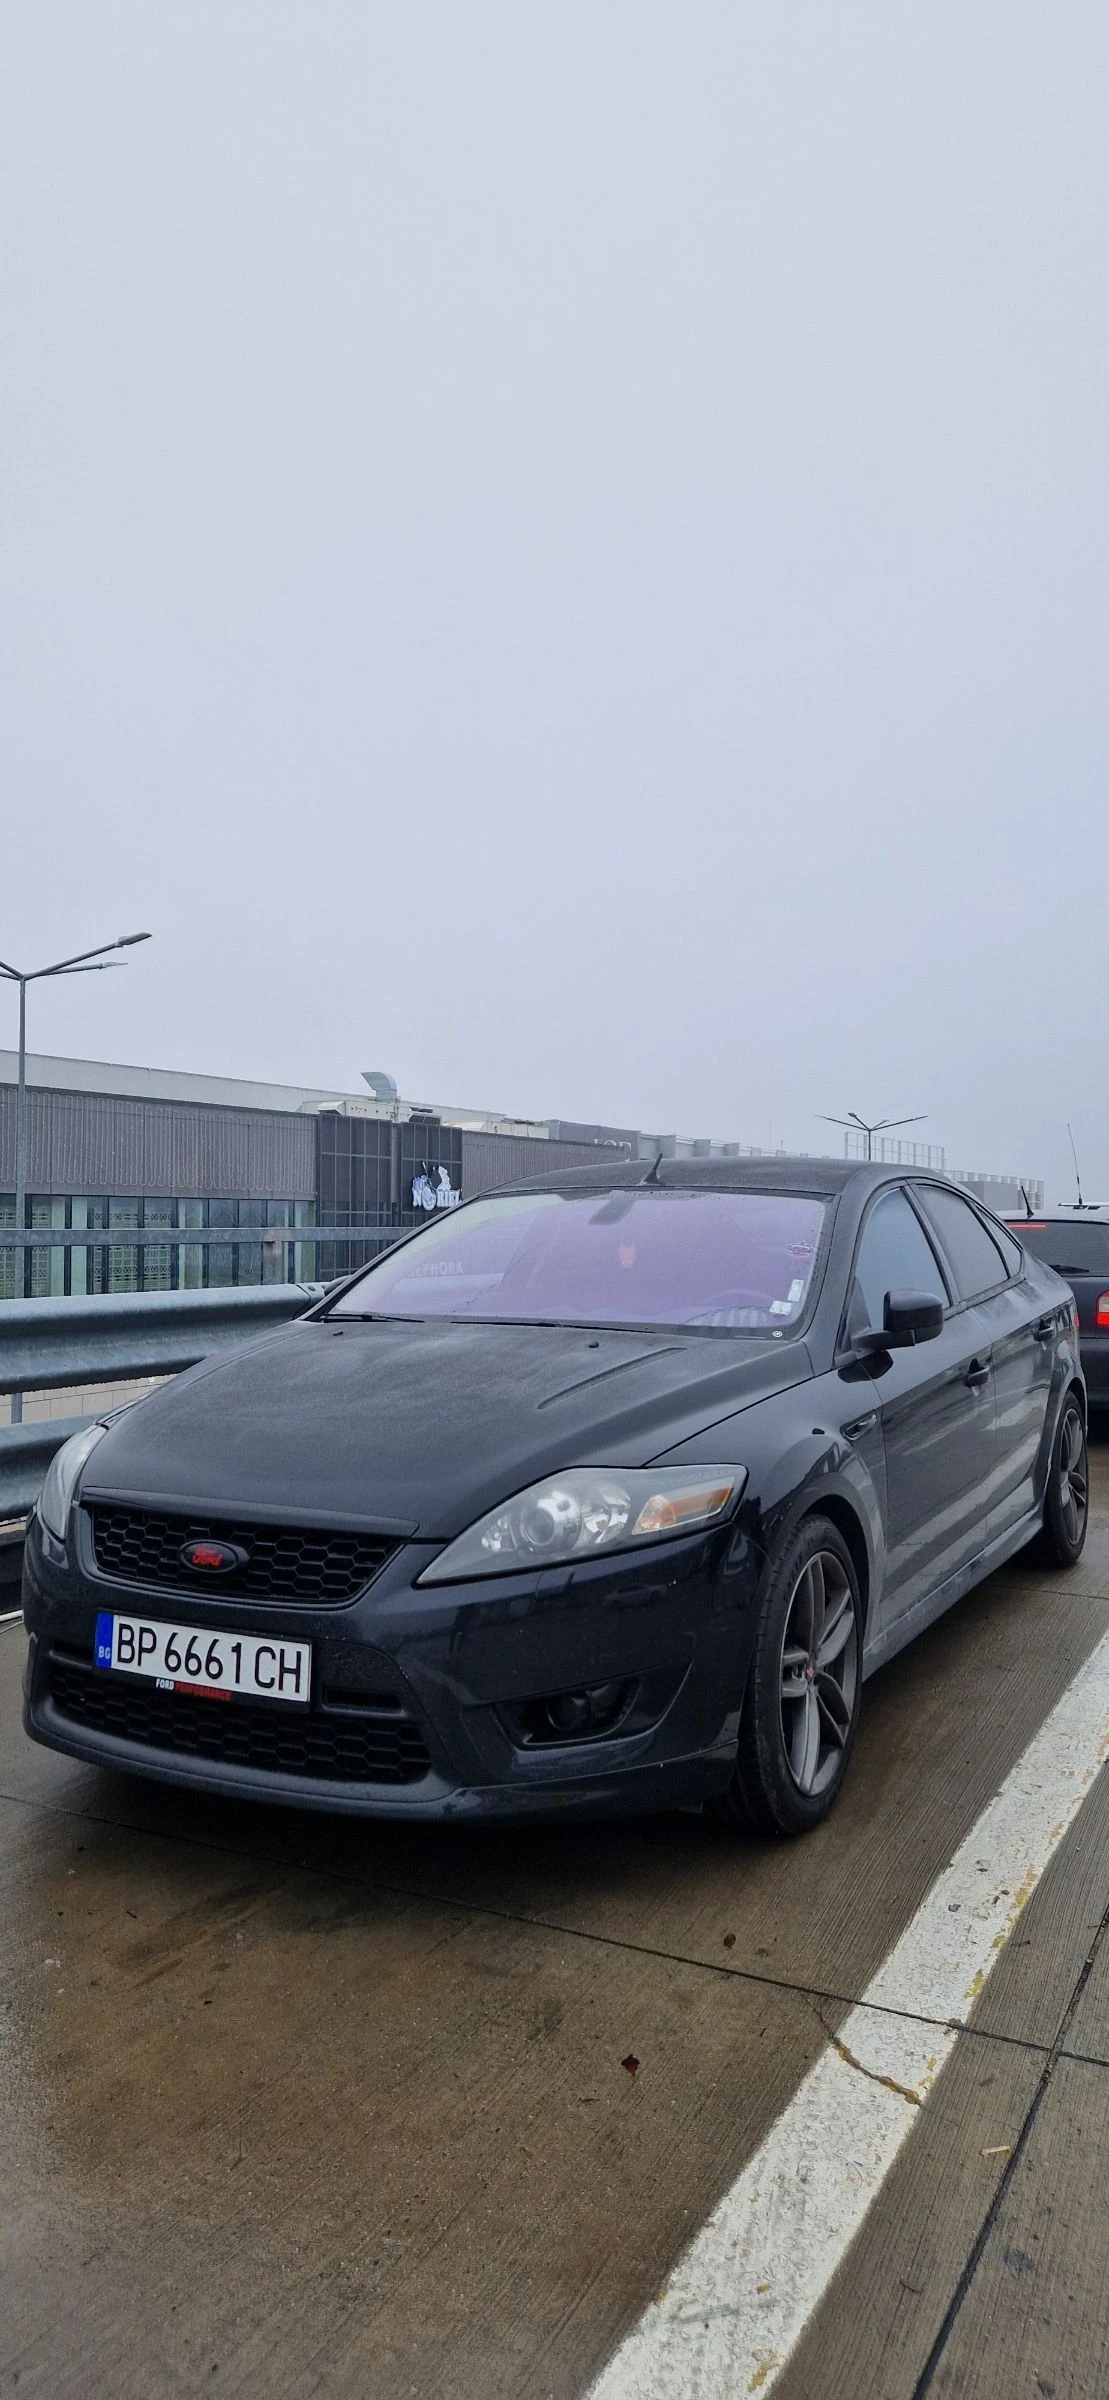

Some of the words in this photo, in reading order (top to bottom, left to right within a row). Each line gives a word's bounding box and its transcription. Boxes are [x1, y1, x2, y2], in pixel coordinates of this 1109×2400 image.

[98, 1646, 111, 1660] BG
[117, 1623, 157, 1667] BP
[164, 1632, 242, 1684] 6661
[254, 1645, 302, 1693] CH
[155, 1677, 174, 1691] FORD
